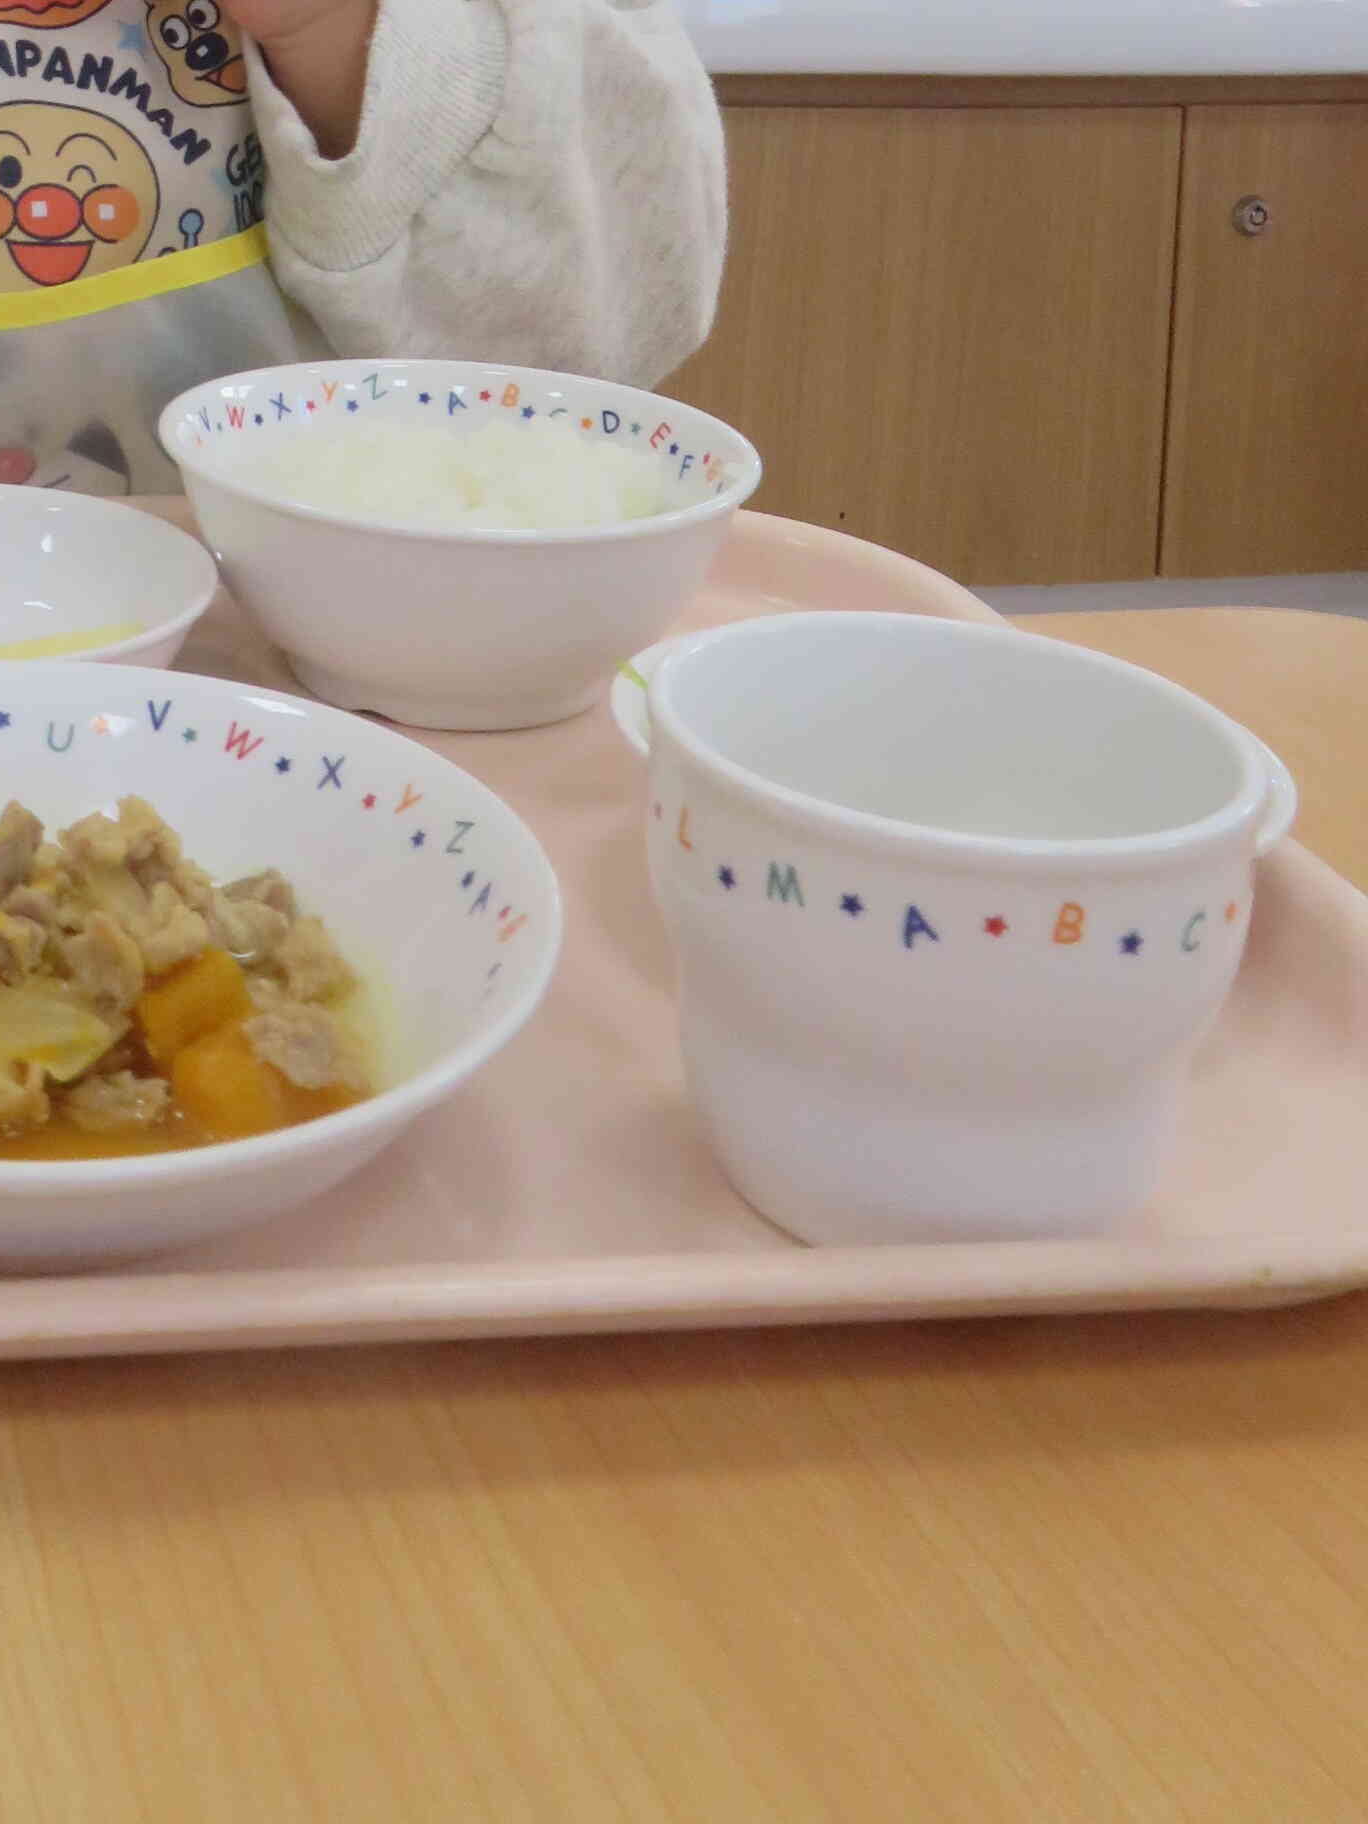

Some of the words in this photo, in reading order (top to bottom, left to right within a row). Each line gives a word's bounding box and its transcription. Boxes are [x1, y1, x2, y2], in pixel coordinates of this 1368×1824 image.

[226, 403, 246, 430] W
[268, 391, 292, 421] X
[321, 379, 338, 405] Y
[361, 372, 388, 401] Z
[448, 391, 469, 416] A
[501, 383, 520, 408] B
[601, 409, 621, 434] D
[648, 421, 673, 449] E
[679, 454, 694, 480] F
[46, 721, 75, 753] U
[147, 699, 172, 732] V
[224, 721, 265, 760] W
[316, 755, 346, 790] X
[394, 783, 423, 815] Y
[445, 820, 475, 854] Z
[677, 807, 692, 852] L
[765, 861, 805, 908] M
[902, 904, 939, 949] A
[1051, 901, 1086, 945] B
[1180, 911, 1206, 953] C
